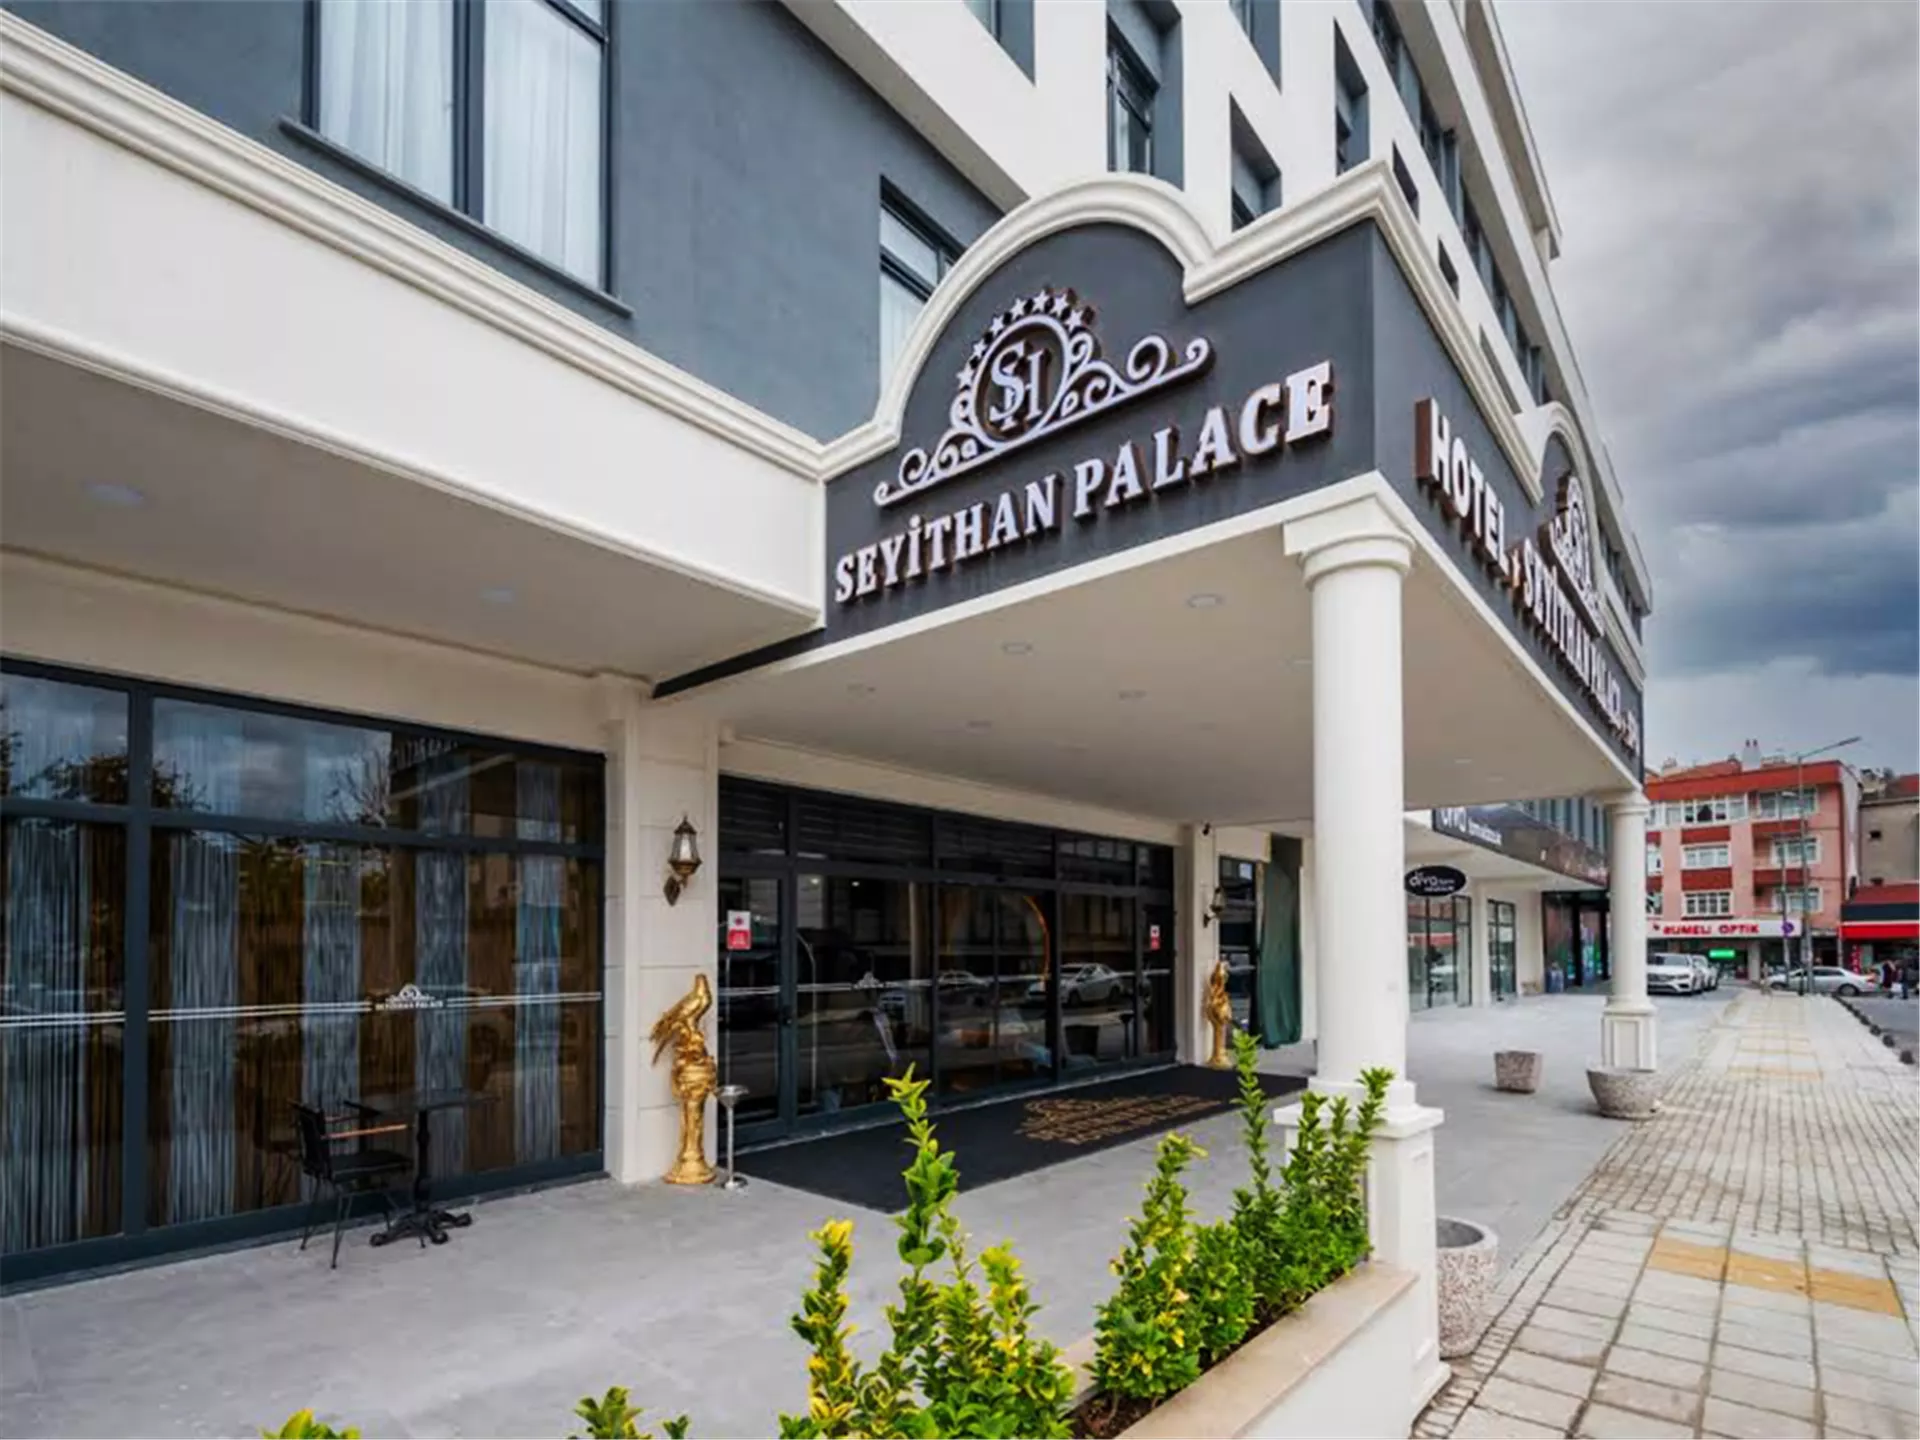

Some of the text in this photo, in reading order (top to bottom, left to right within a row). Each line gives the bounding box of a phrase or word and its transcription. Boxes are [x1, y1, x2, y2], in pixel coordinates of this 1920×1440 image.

[836, 361, 1332, 602] SEYİTHAN PALACE
[1430, 397, 1510, 576] HOTEL
